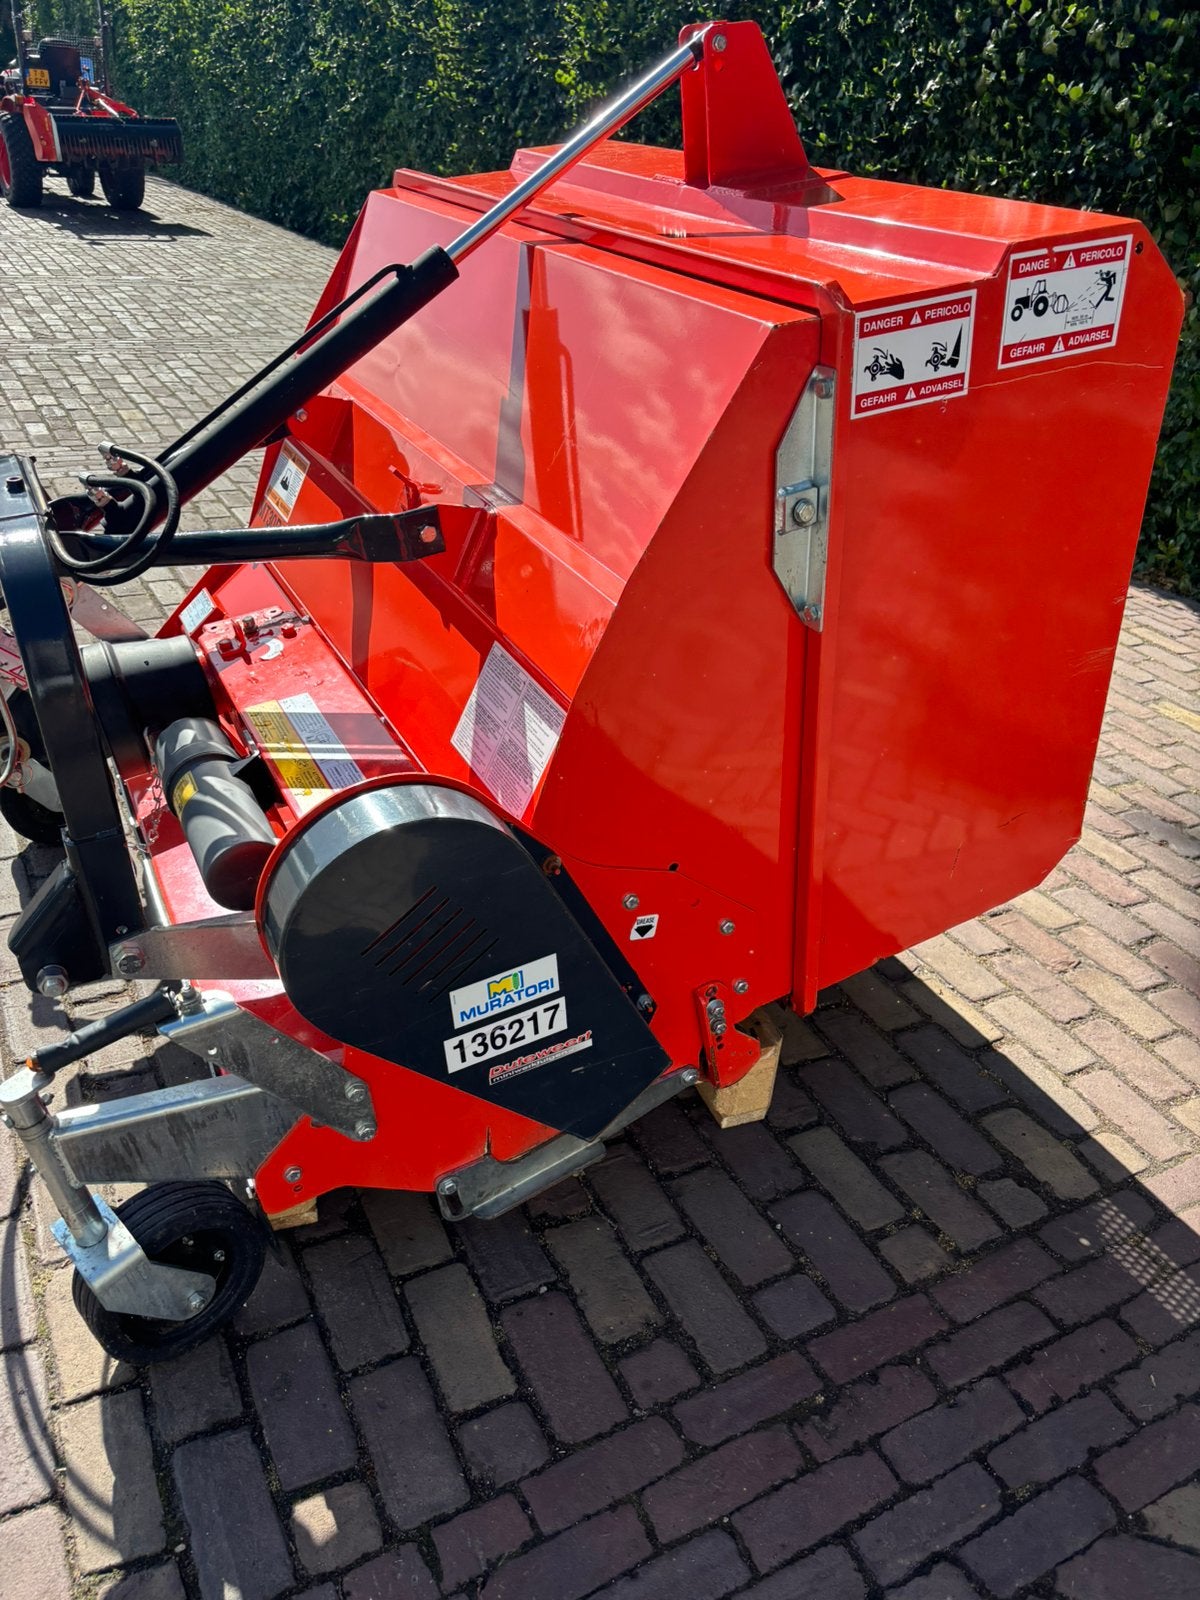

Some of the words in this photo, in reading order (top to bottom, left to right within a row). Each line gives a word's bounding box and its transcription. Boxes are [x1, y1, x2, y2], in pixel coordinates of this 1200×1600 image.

[1018, 256, 1057, 274] DANGE
[1080, 246, 1124, 263] PERICOLO
[863, 315, 904, 333] DANGER
[924, 302, 971, 320] PERICOLO
[1009, 342, 1046, 358] GEFAHR
[1068, 329, 1111, 347] ADVARSEL
[860, 391, 898, 408] GEFAHR
[919, 379, 964, 396] ADVARSEL
[459, 977, 555, 1023] MURATORI
[452, 1003, 560, 1064] 136217
[489, 1030, 593, 1078] Duteweert
